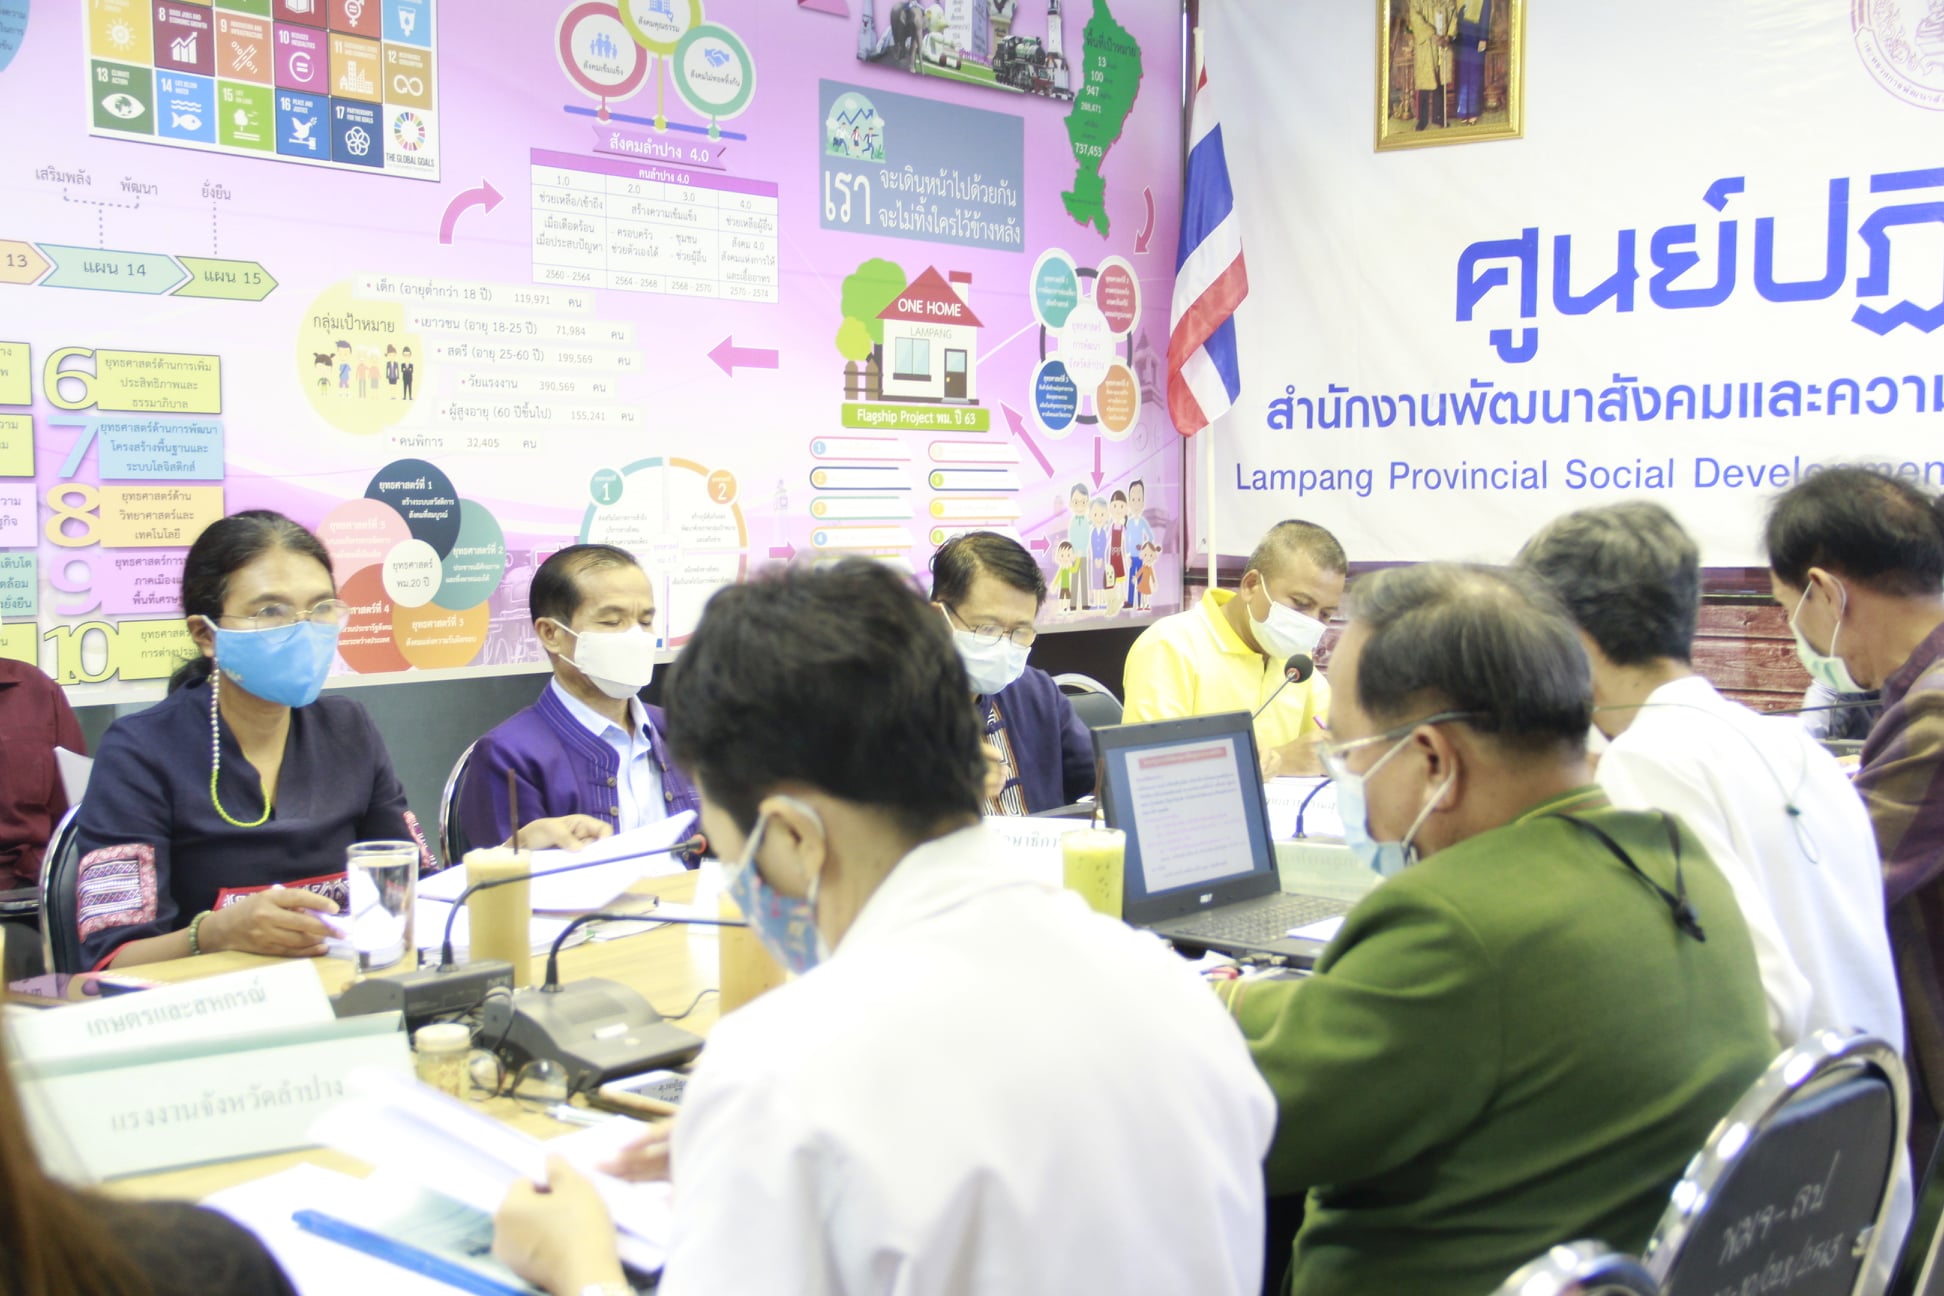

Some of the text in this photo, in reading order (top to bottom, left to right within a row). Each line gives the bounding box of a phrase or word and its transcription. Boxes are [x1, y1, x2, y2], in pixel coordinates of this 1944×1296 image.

[159, 7, 166, 21] 8
[220, 18, 227, 33] 9
[279, 30, 290, 44] 10
[334, 40, 343, 54] 11
[388, 50, 397, 64] 12
[1098, 56, 1107, 68] 13
[96, 67, 109, 82] 13
[1091, 71, 1104, 83] 100
[161, 78, 173, 93] 14
[223, 88, 233, 103] 15
[280, 97, 292, 112] 16
[336, 106, 345, 120] 17
[609, 132, 709, 163] สังคมลำปาง 4.0
[386, 152, 396, 163] THE
[397, 154, 417, 165] GLOBAL
[417, 156, 435, 167] GOALS
[35, 166, 92, 186] เสริมพลัง
[557, 175, 570, 186] 1.0
[639, 167, 690, 185] คนลำปาง 4.0
[120, 177, 158, 196] พัฒนา
[201, 179, 232, 201] ยั่งยืน
[628, 184, 641, 195] 2.0
[879, 164, 1017, 208] จะเดินหน้าไปด้วยกัน
[683, 192, 696, 202] 3.0
[824, 170, 871, 225] เรา
[878, 196, 1021, 245] จะไม่ทิ้งใครไว้ข้างหลัง
[6, 254, 28, 268] 13
[83, 261, 147, 277] แผน 14
[204, 270, 262, 285] แผน 15
[376, 279, 396, 294] เด็ก
[463, 287, 477, 300] 18
[514, 292, 551, 306] 119,971
[568, 296, 582, 309] คน
[897, 298, 962, 317] ONE HOME
[313, 312, 395, 335] กลุ่มเป้าหมาย
[421, 318, 460, 330] เยาวชน
[493, 321, 522, 334] 18-25
[556, 325, 587, 337] 71,984
[611, 329, 625, 341] คน
[910, 326, 952, 340] LAMPANG
[447, 344, 469, 358] สตรี
[499, 349, 529, 361] 25-60
[618, 354, 631, 367] คน
[43, 347, 97, 410] 6
[120, 377, 198, 390] ประสิทธิภาพและ
[468, 374, 519, 389] วัยแรงงาน
[592, 382, 607, 393] คน
[132, 397, 188, 409] ธรรมาภิบาล
[449, 402, 489, 421] ผู้สูงอายุ
[621, 411, 635, 422] คน
[857, 408, 898, 425] Flagship
[900, 410, 934, 426] Project
[964, 412, 976, 424] 63
[100, 421, 218, 435] ยุทธศาสตร์ด้านการพัฒนา
[48, 416, 99, 478] 7
[400, 433, 537, 449] คนพิการ 32,405 คน
[379, 476, 433, 494] ยุทธศาสตร์ที่ 1
[1236, 462, 1373, 497] Lampang
[1389, 460, 1548, 490] Provincial
[1565, 458, 1675, 489] Social
[122, 490, 191, 504] ยุทธศาสตร์ด้าน
[603, 483, 610, 501] 1
[718, 483, 727, 501] 2
[46, 483, 100, 548] 8
[119, 509, 194, 521] วิทยาศาสตร์และ
[135, 528, 181, 540] เทคโนโลยี
[498, 545, 504, 555] 2
[50, 552, 101, 616] 9
[384, 604, 390, 614] 4
[44, 621, 119, 685] 10
[87, 976, 267, 1037] เกษตรและสหกรณ์
[111, 1075, 345, 1132] แรงงานจังหวัดลำปาง
